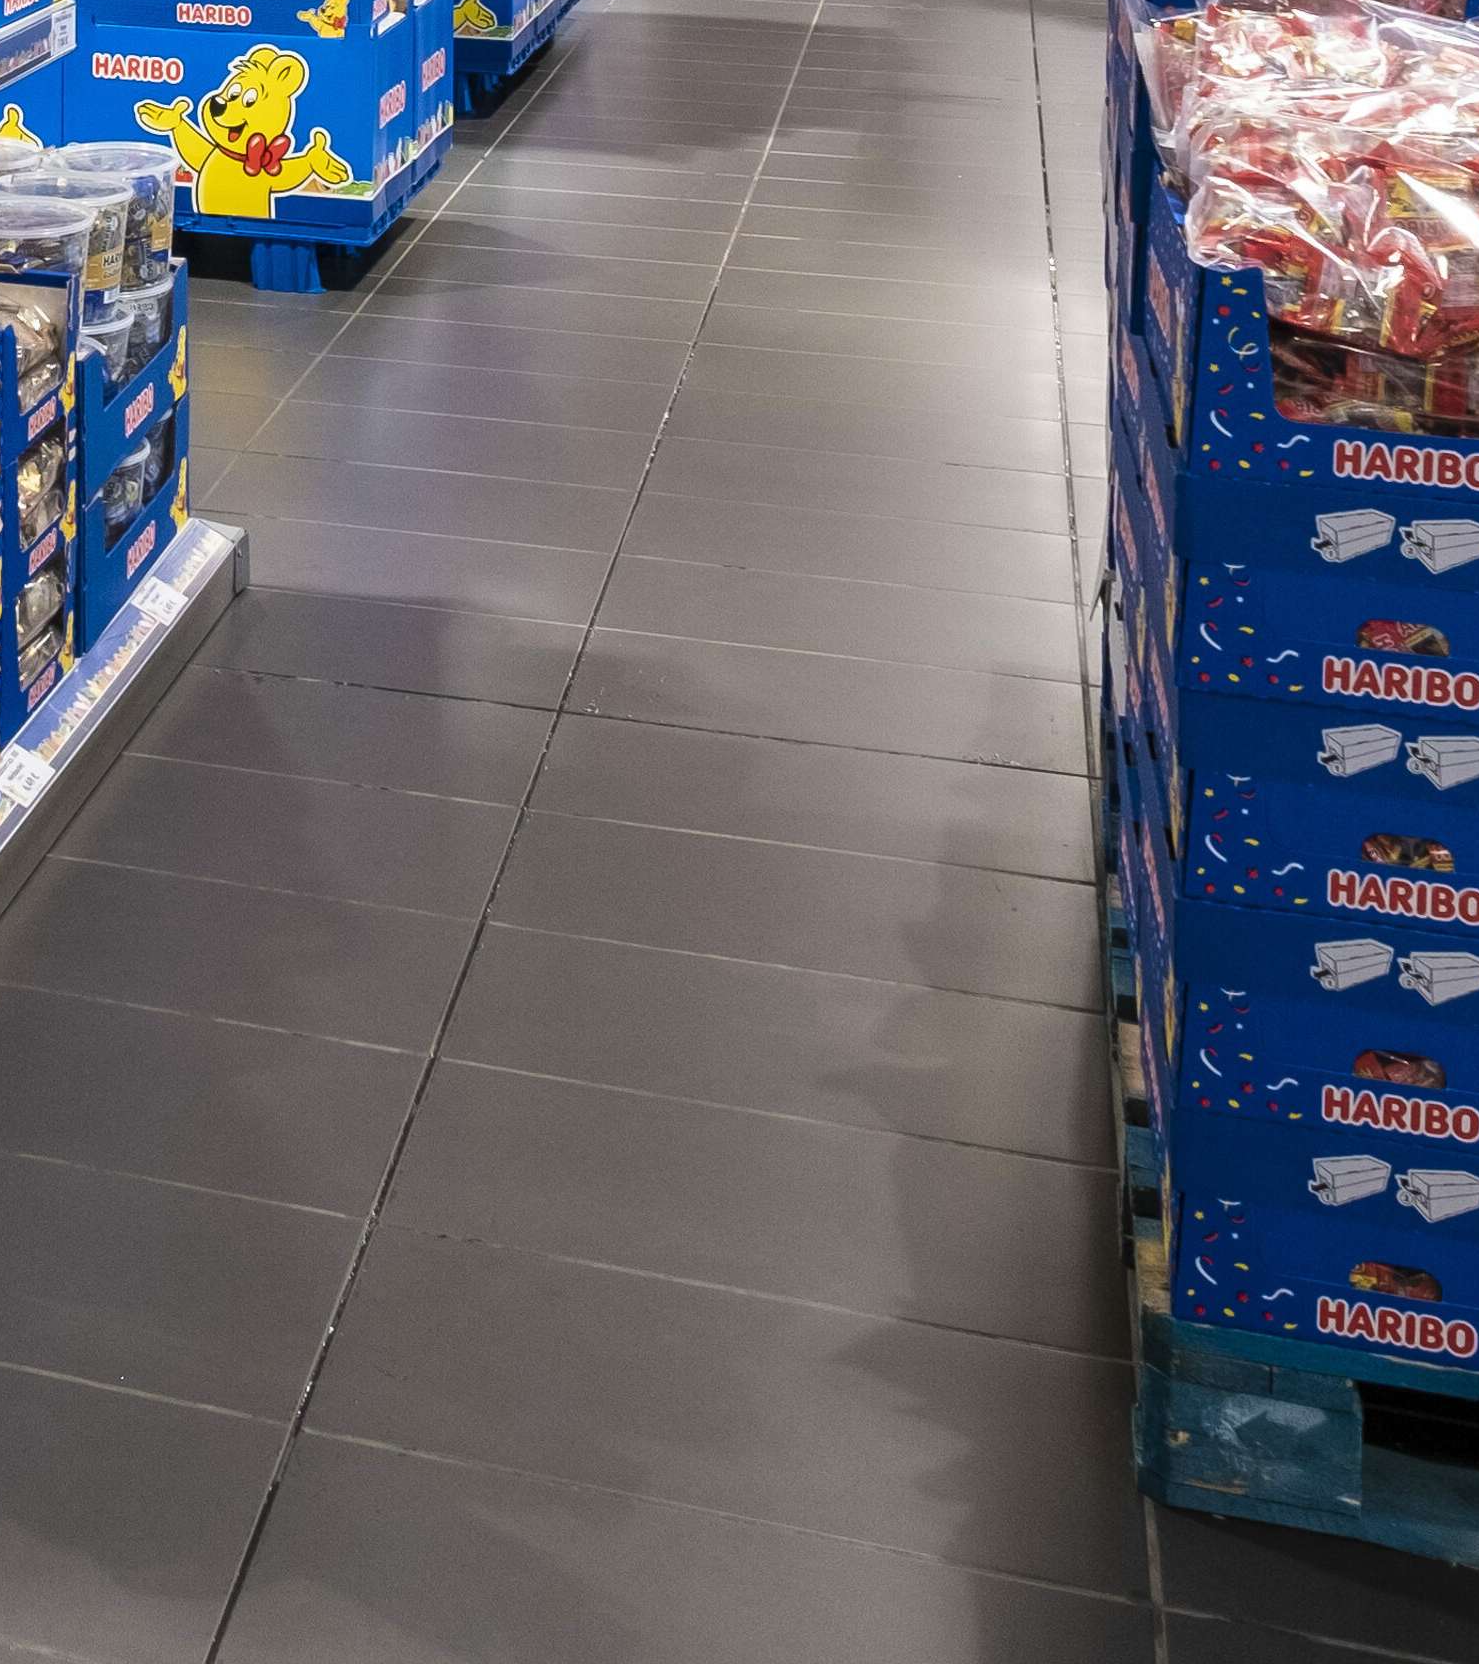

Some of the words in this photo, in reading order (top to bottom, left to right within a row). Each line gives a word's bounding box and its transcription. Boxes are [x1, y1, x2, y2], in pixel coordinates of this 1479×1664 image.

[176, 3, 252, 26] HARIBO
[92, 53, 184, 84] HARIBO
[422, 48, 447, 92] HARIBO
[1315, 1296, 1478, 1359] HARIBO
